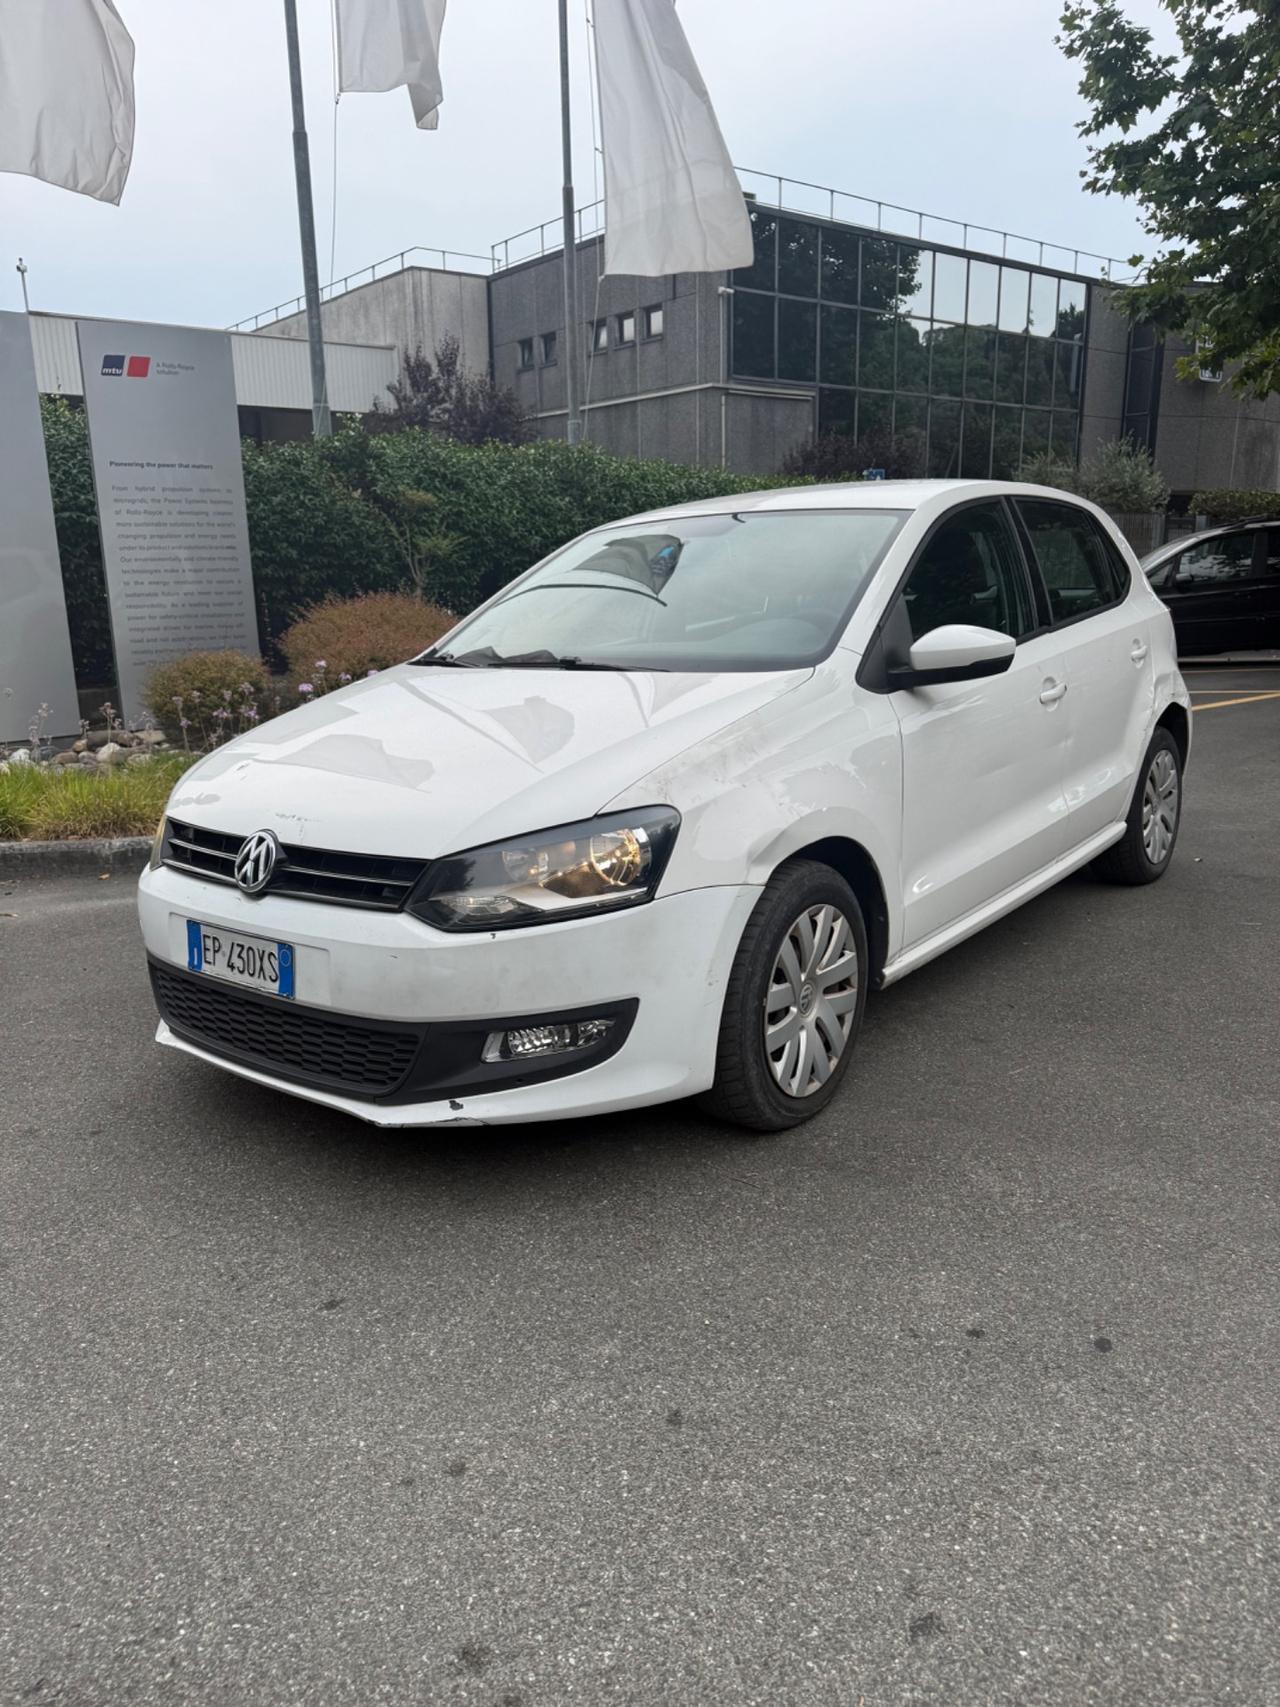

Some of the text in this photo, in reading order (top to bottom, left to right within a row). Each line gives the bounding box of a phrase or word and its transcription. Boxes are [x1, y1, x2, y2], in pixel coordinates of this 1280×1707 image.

[109, 461, 144, 469] Pioneering
[203, 934, 280, 983] EP 430XS
